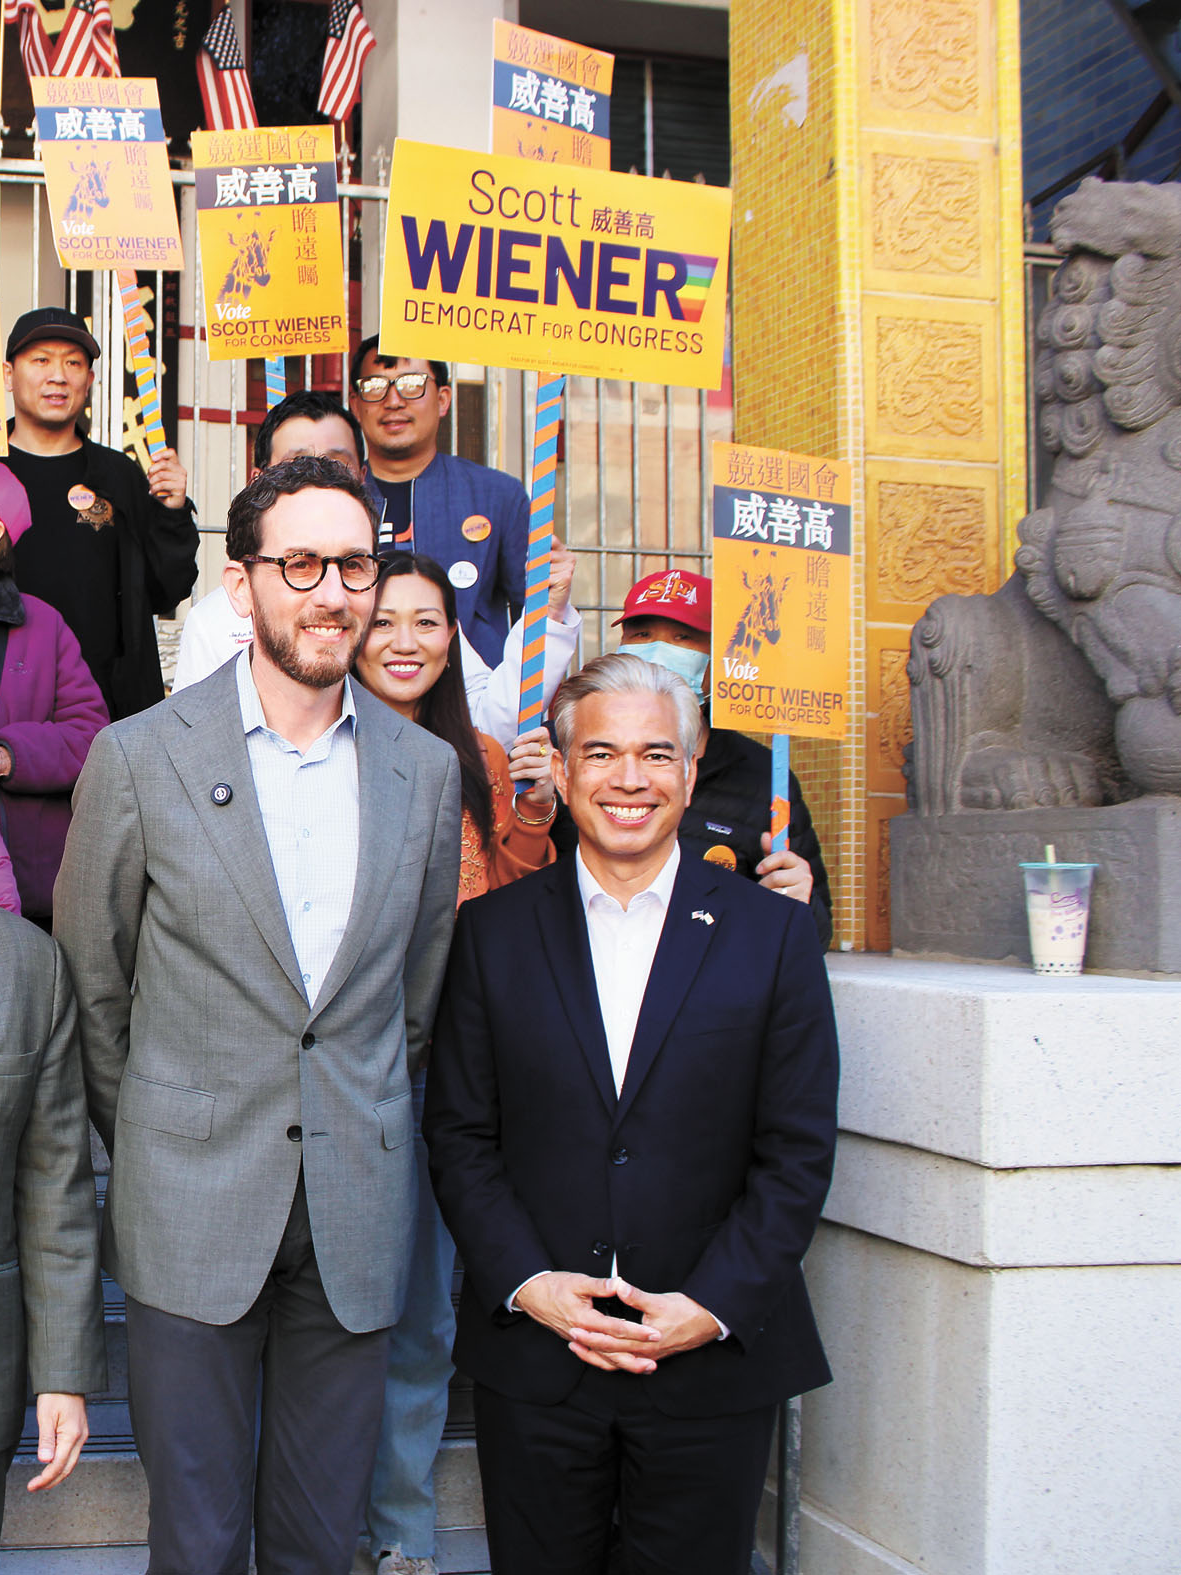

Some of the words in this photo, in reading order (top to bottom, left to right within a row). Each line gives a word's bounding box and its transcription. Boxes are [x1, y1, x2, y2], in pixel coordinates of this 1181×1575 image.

[507, 30, 602, 87] 競選國會
[508, 70, 597, 133] 威善高
[54, 107, 146, 141] 威善高
[208, 130, 320, 164] 競選國會
[214, 163, 318, 207] 威善高
[469, 169, 582, 228] Scott
[590, 206, 655, 240] 威善高
[59, 237, 113, 249] SCOTT
[116, 237, 177, 250] WIENER
[61, 220, 95, 236] Vote
[73, 251, 93, 260] FOR
[95, 250, 167, 261] CONGRESS
[401, 215, 689, 322] WIENER
[211, 320, 270, 337] SCOTT
[275, 315, 342, 332] WIENER
[214, 303, 251, 321] Vote
[404, 299, 538, 336] DEMOCRAT
[542, 322, 573, 341] FOR
[578, 320, 704, 355] CONGRESS
[225, 338, 246, 348] FOR
[250, 331, 331, 348] CONGRESS
[727, 449, 839, 500] 競選國會
[730, 493, 835, 551] 威善高
[722, 656, 760, 682] Vote
[717, 680, 776, 702] SCOTT
[780, 688, 843, 711] WIENER
[730, 702, 752, 715] FOR
[754, 702, 832, 725] CONGRESS
